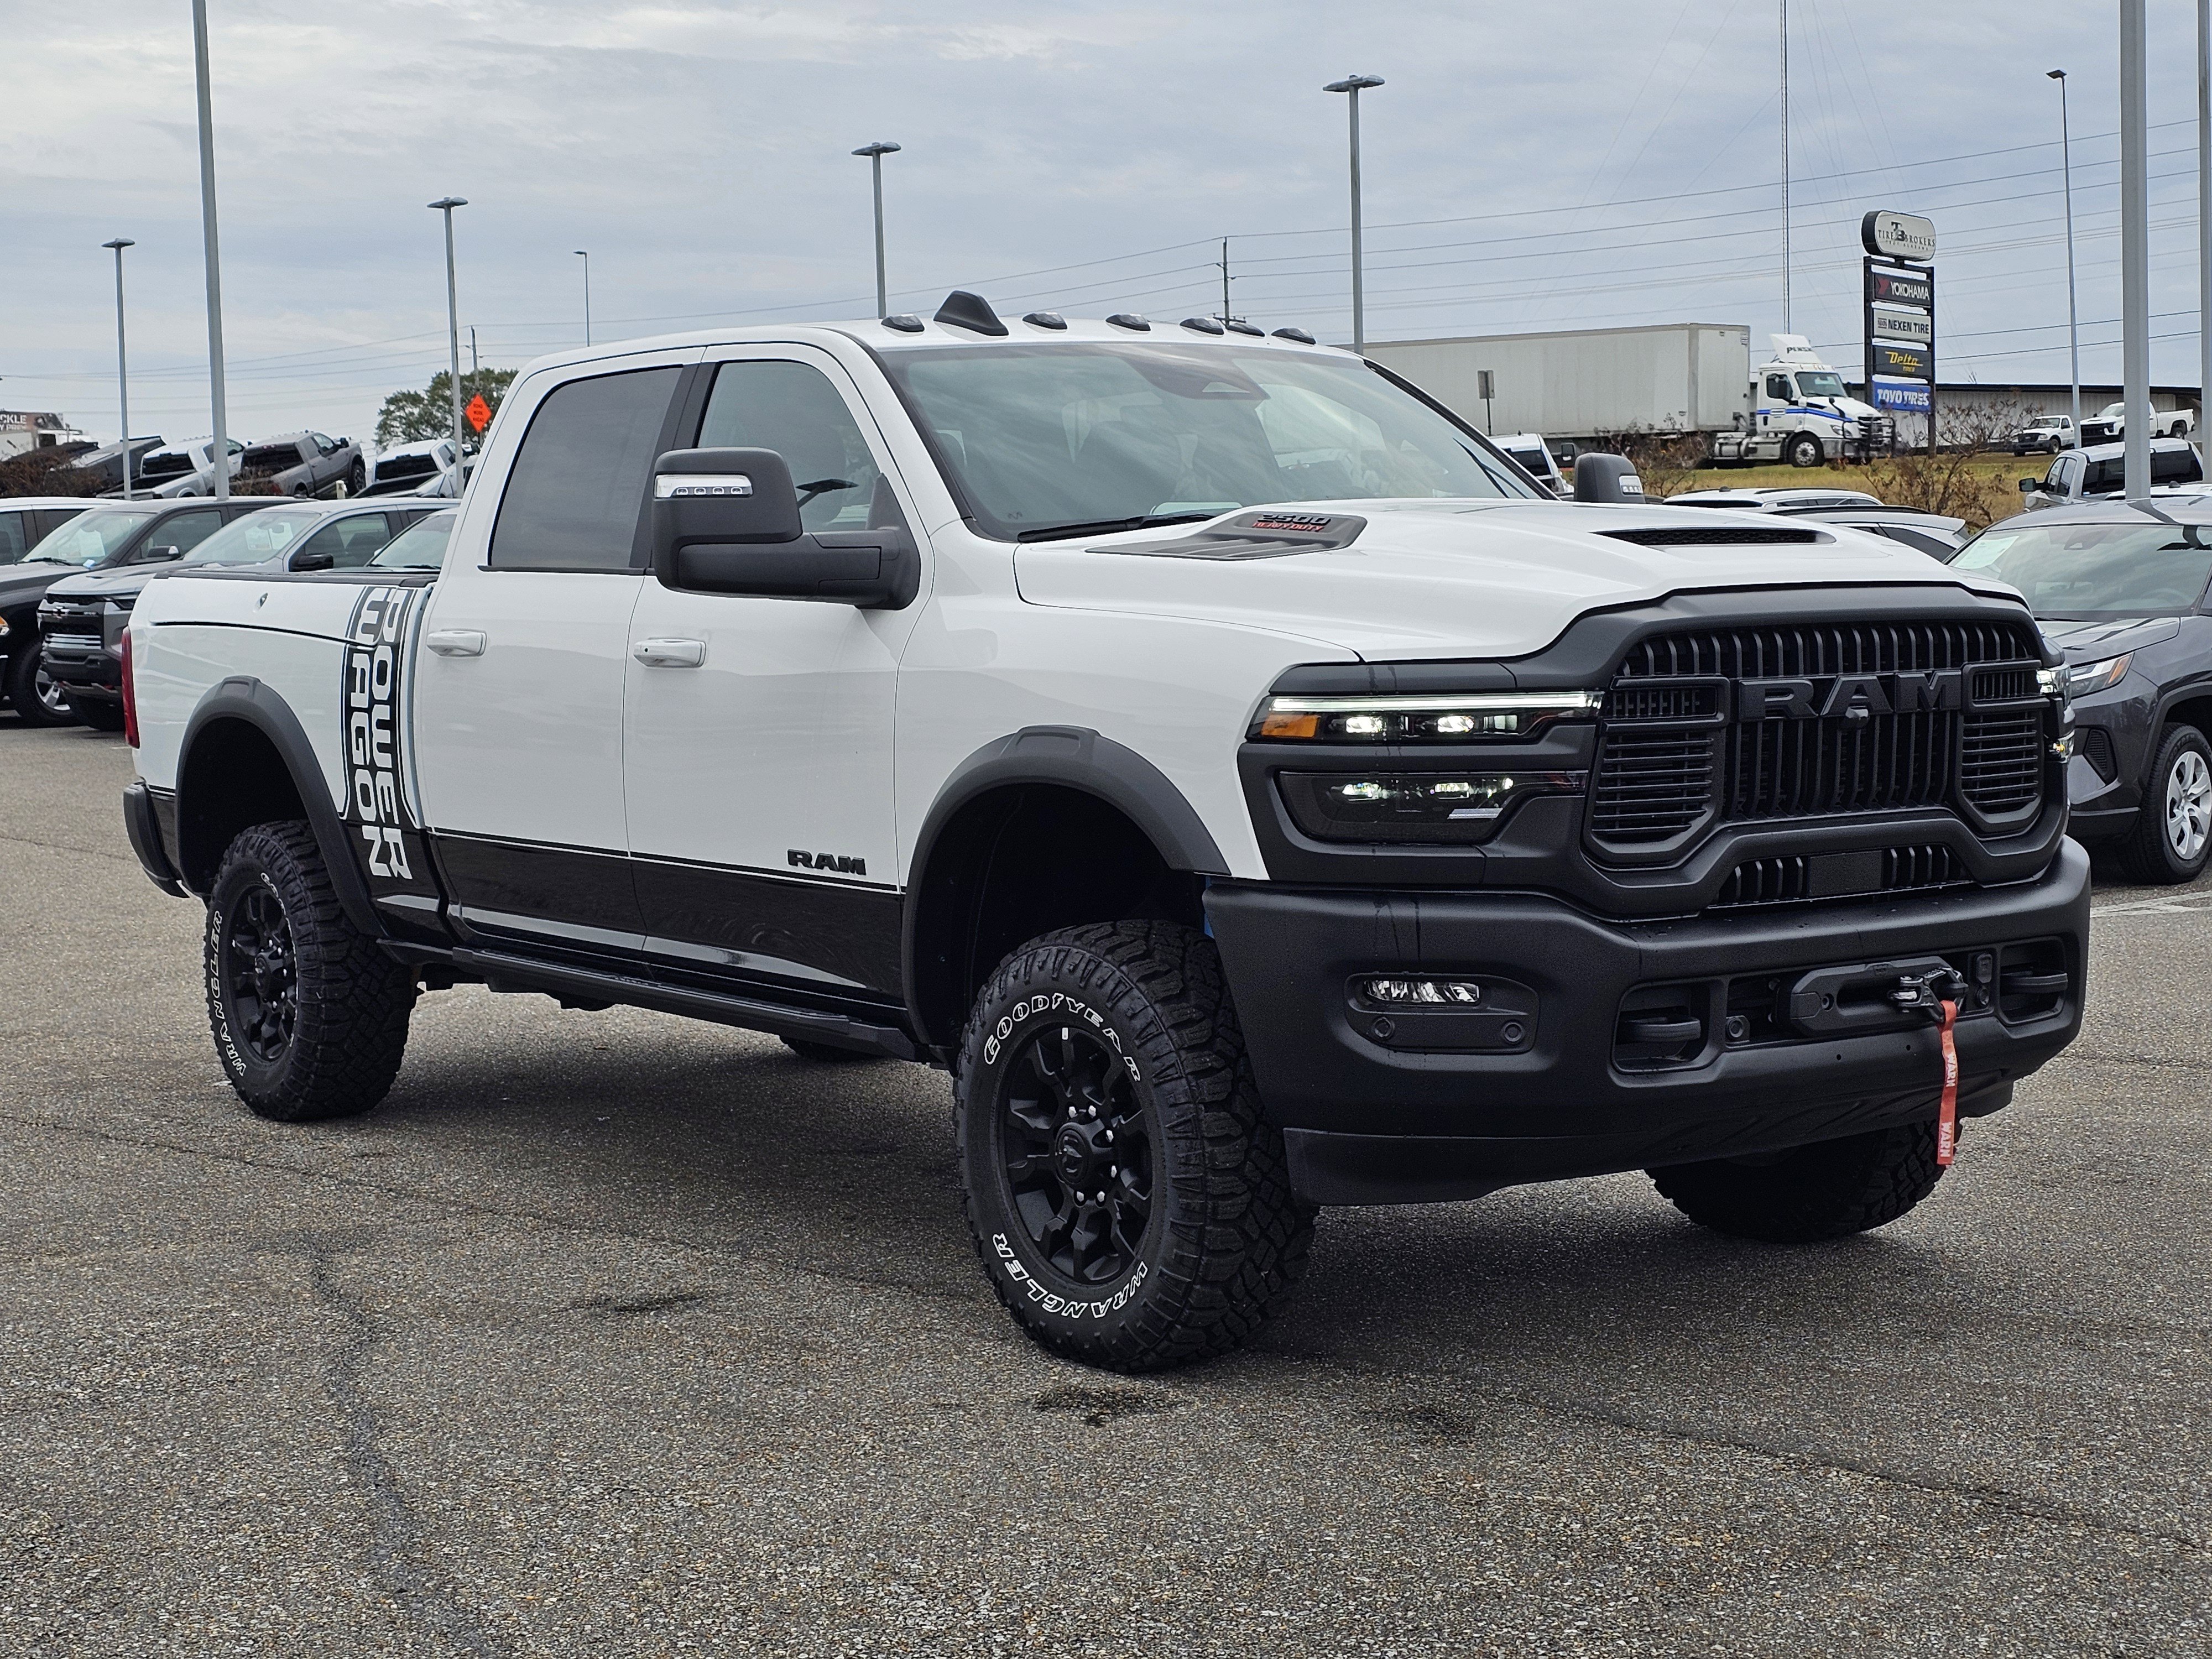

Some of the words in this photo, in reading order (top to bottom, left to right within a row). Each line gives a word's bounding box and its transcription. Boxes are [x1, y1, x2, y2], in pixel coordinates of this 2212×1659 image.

[1878, 229, 1893, 240] TIRE
[1905, 234, 1936, 247] BROKERS
[1890, 281, 1930, 301] YOKOHAMA
[1888, 319, 1912, 332] NEXEN
[1913, 322, 1930, 335] TIRE
[1885, 351, 1923, 367] Delta
[1877, 389, 1902, 404] TOYO
[1903, 391, 1930, 406] TIRES
[1251, 521, 1293, 530] HEAVY
[1289, 524, 1325, 533] DUTY
[1257, 513, 1332, 525] 2500
[1739, 670, 1961, 721] RAM
[351, 587, 393, 878] WAGON
[371, 588, 413, 880] POWER
[787, 849, 867, 876] RAM
[210, 910, 247, 1077] WRANGLER
[984, 993, 1141, 1082] GOODYEAR
[1945, 1053, 1956, 1087] WARN
[1940, 1121, 1952, 1157] WARN
[993, 1233, 1148, 1318] WRANGLER
